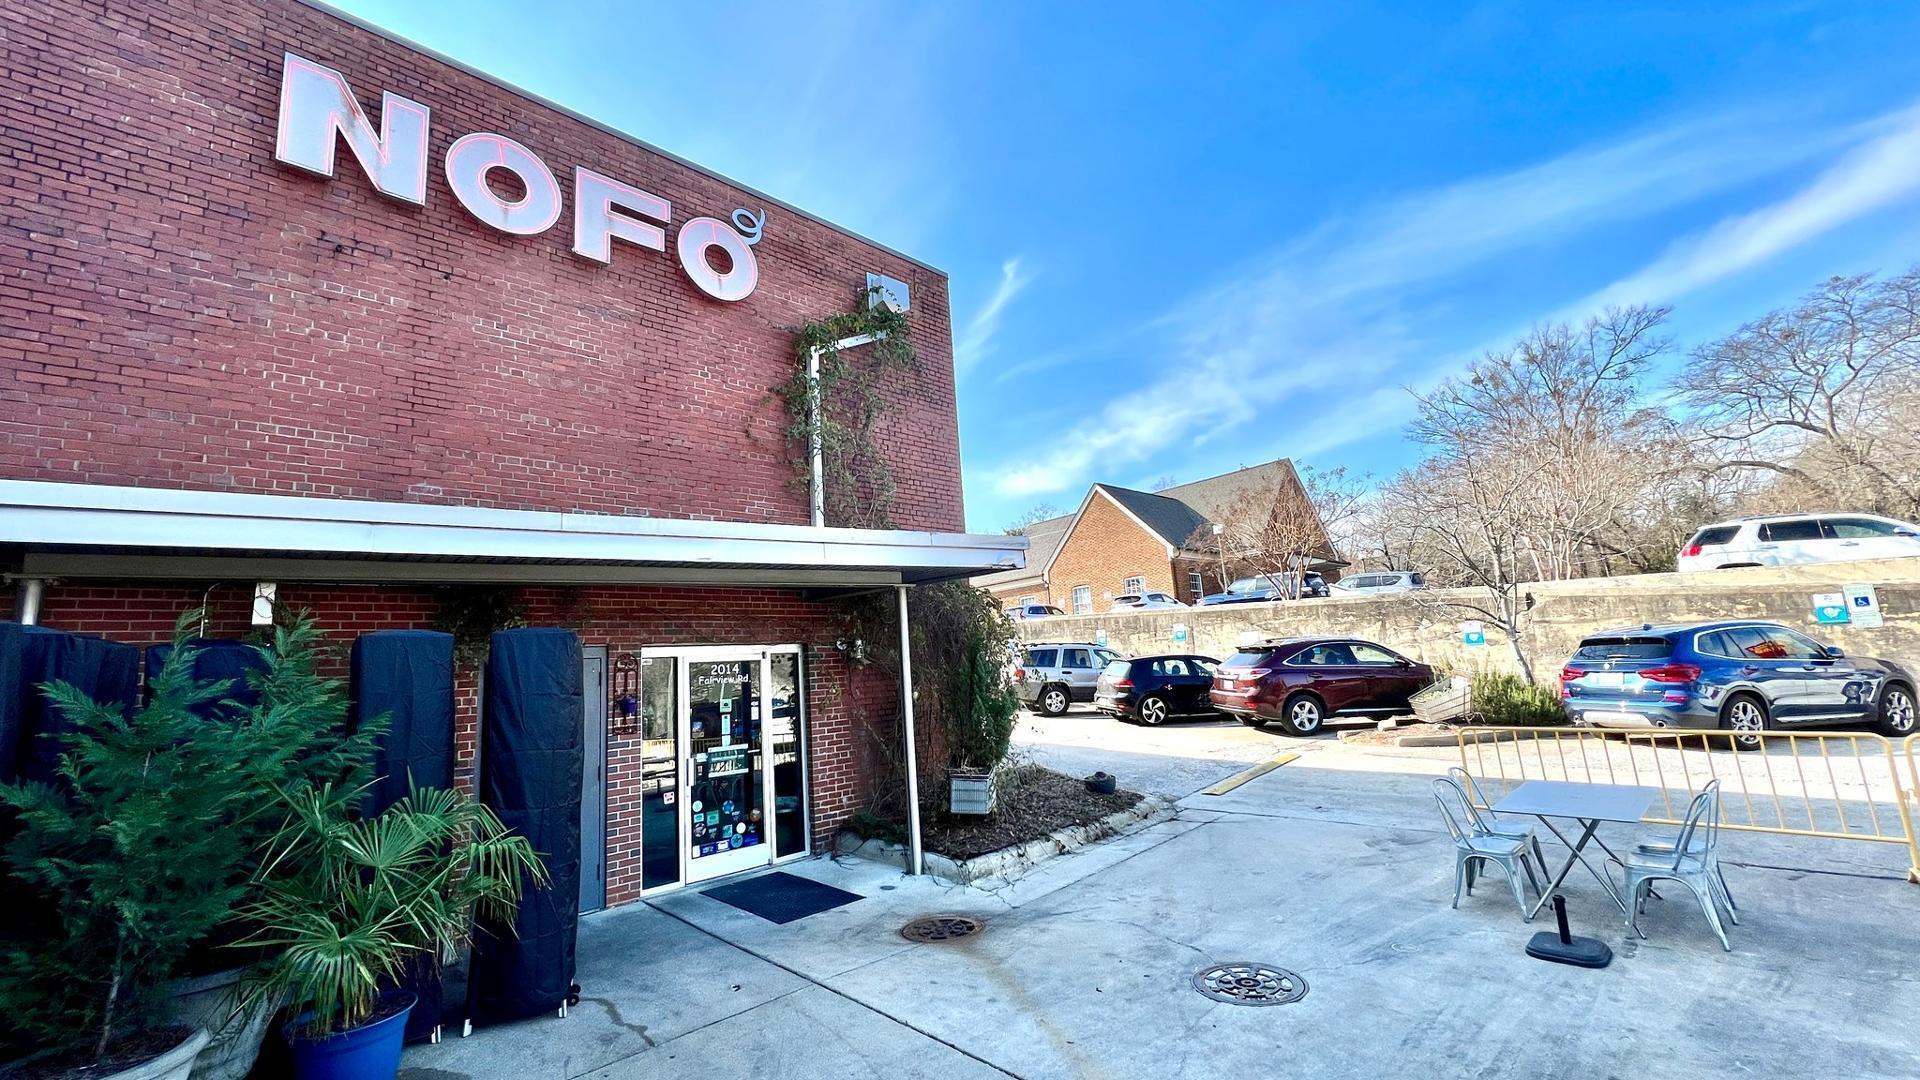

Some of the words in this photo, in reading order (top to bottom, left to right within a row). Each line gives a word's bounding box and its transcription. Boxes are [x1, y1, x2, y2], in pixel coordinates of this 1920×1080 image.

[275, 51, 759, 302] NOFO
[711, 663, 740, 675] 2014
[698, 676, 735, 685] Fairview
[737, 673, 752, 683] Rd.
